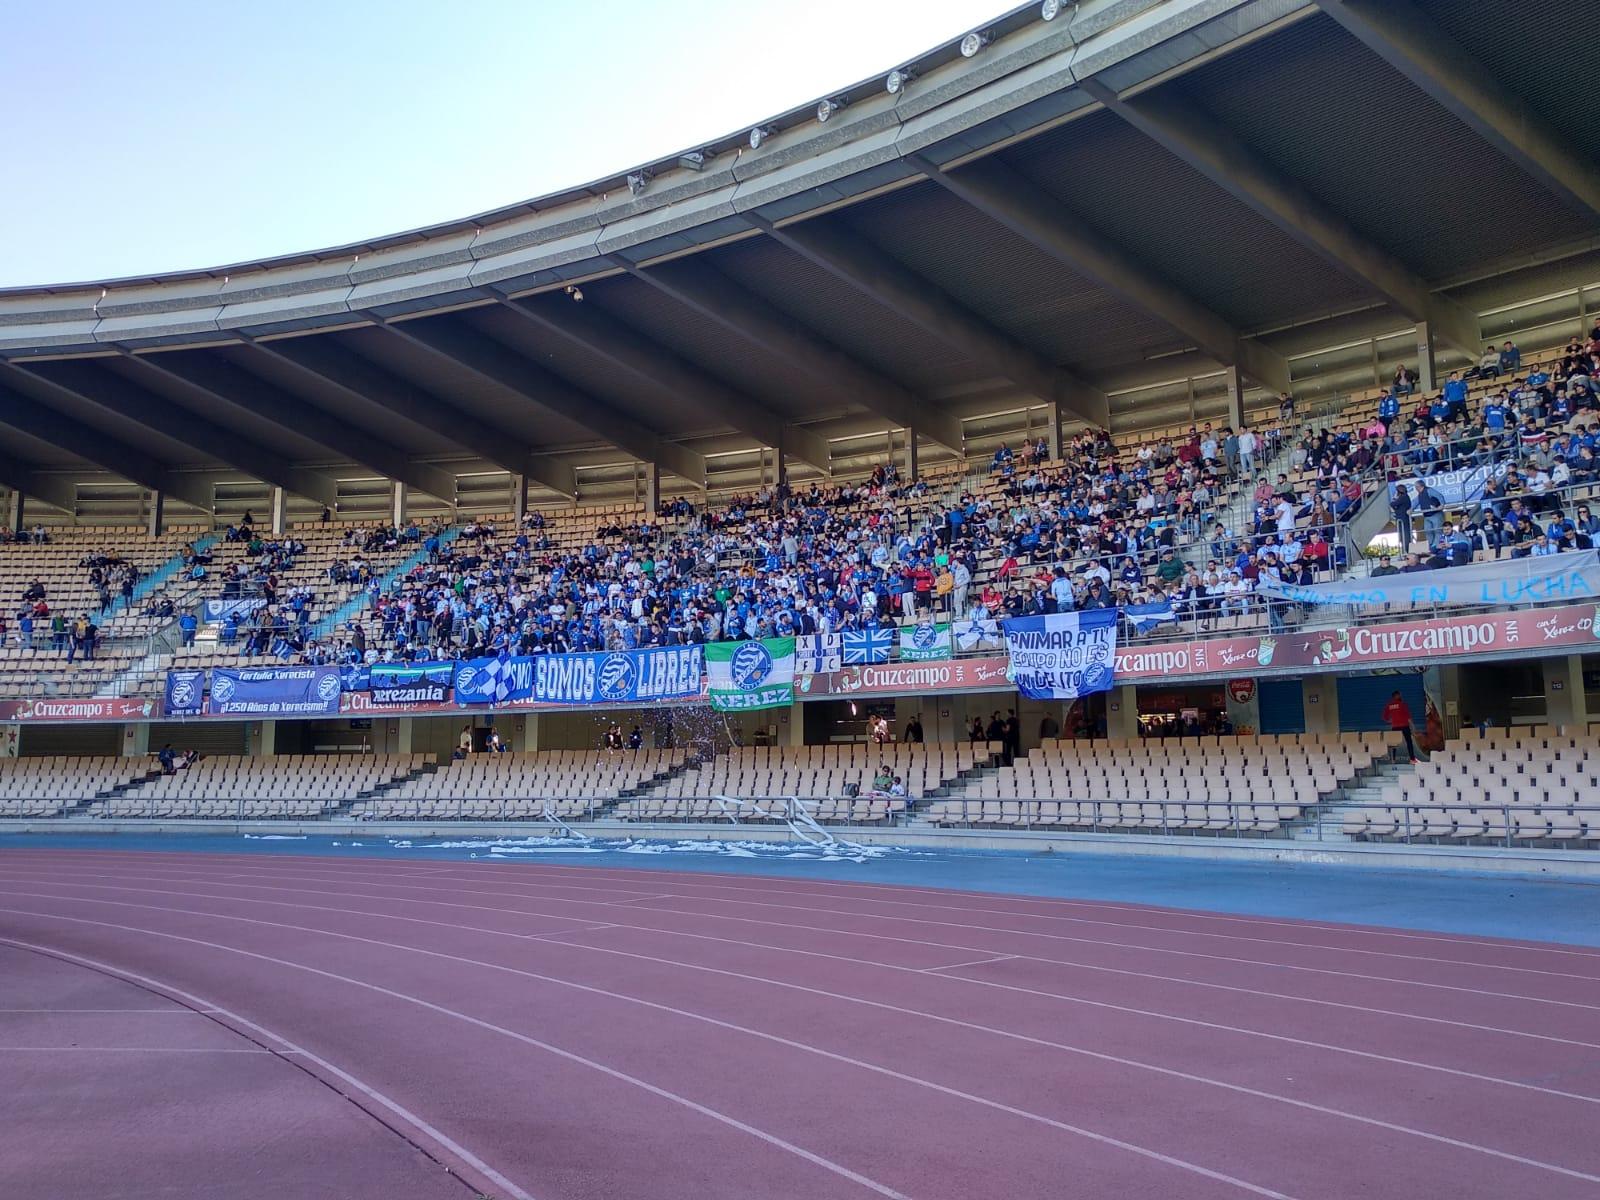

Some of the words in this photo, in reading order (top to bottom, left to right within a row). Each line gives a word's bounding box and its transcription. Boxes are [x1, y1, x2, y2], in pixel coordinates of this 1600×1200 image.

[1411, 585, 1448, 602] EN
[1480, 571, 1593, 604] LUCHA
[1010, 630, 1072, 650] ANIMAR
[1077, 631, 1087, 645] A
[1354, 623, 1495, 655] Cruzcampo
[1505, 620, 1519, 642] SIN
[1544, 625, 1575, 640] Xerez
[1577, 618, 1592, 630] CD
[802, 636, 808, 648] X
[827, 634, 834, 646] D
[803, 660, 809, 671] F
[828, 658, 834, 669] C
[901, 649, 948, 660] XEREZ
[1060, 646, 1082, 669] NO
[1086, 641, 1110, 664] ES
[1114, 650, 1188, 674] zcampo
[1195, 648, 1204, 667] SIN
[535, 656, 596, 700] SOMOS
[636, 647, 700, 698] LIBRES
[863, 666, 950, 688] Cruzcampo
[956, 665, 964, 682] SIN
[712, 688, 791, 708] XEREZ
[34, 701, 102, 718] Cruzcampo
